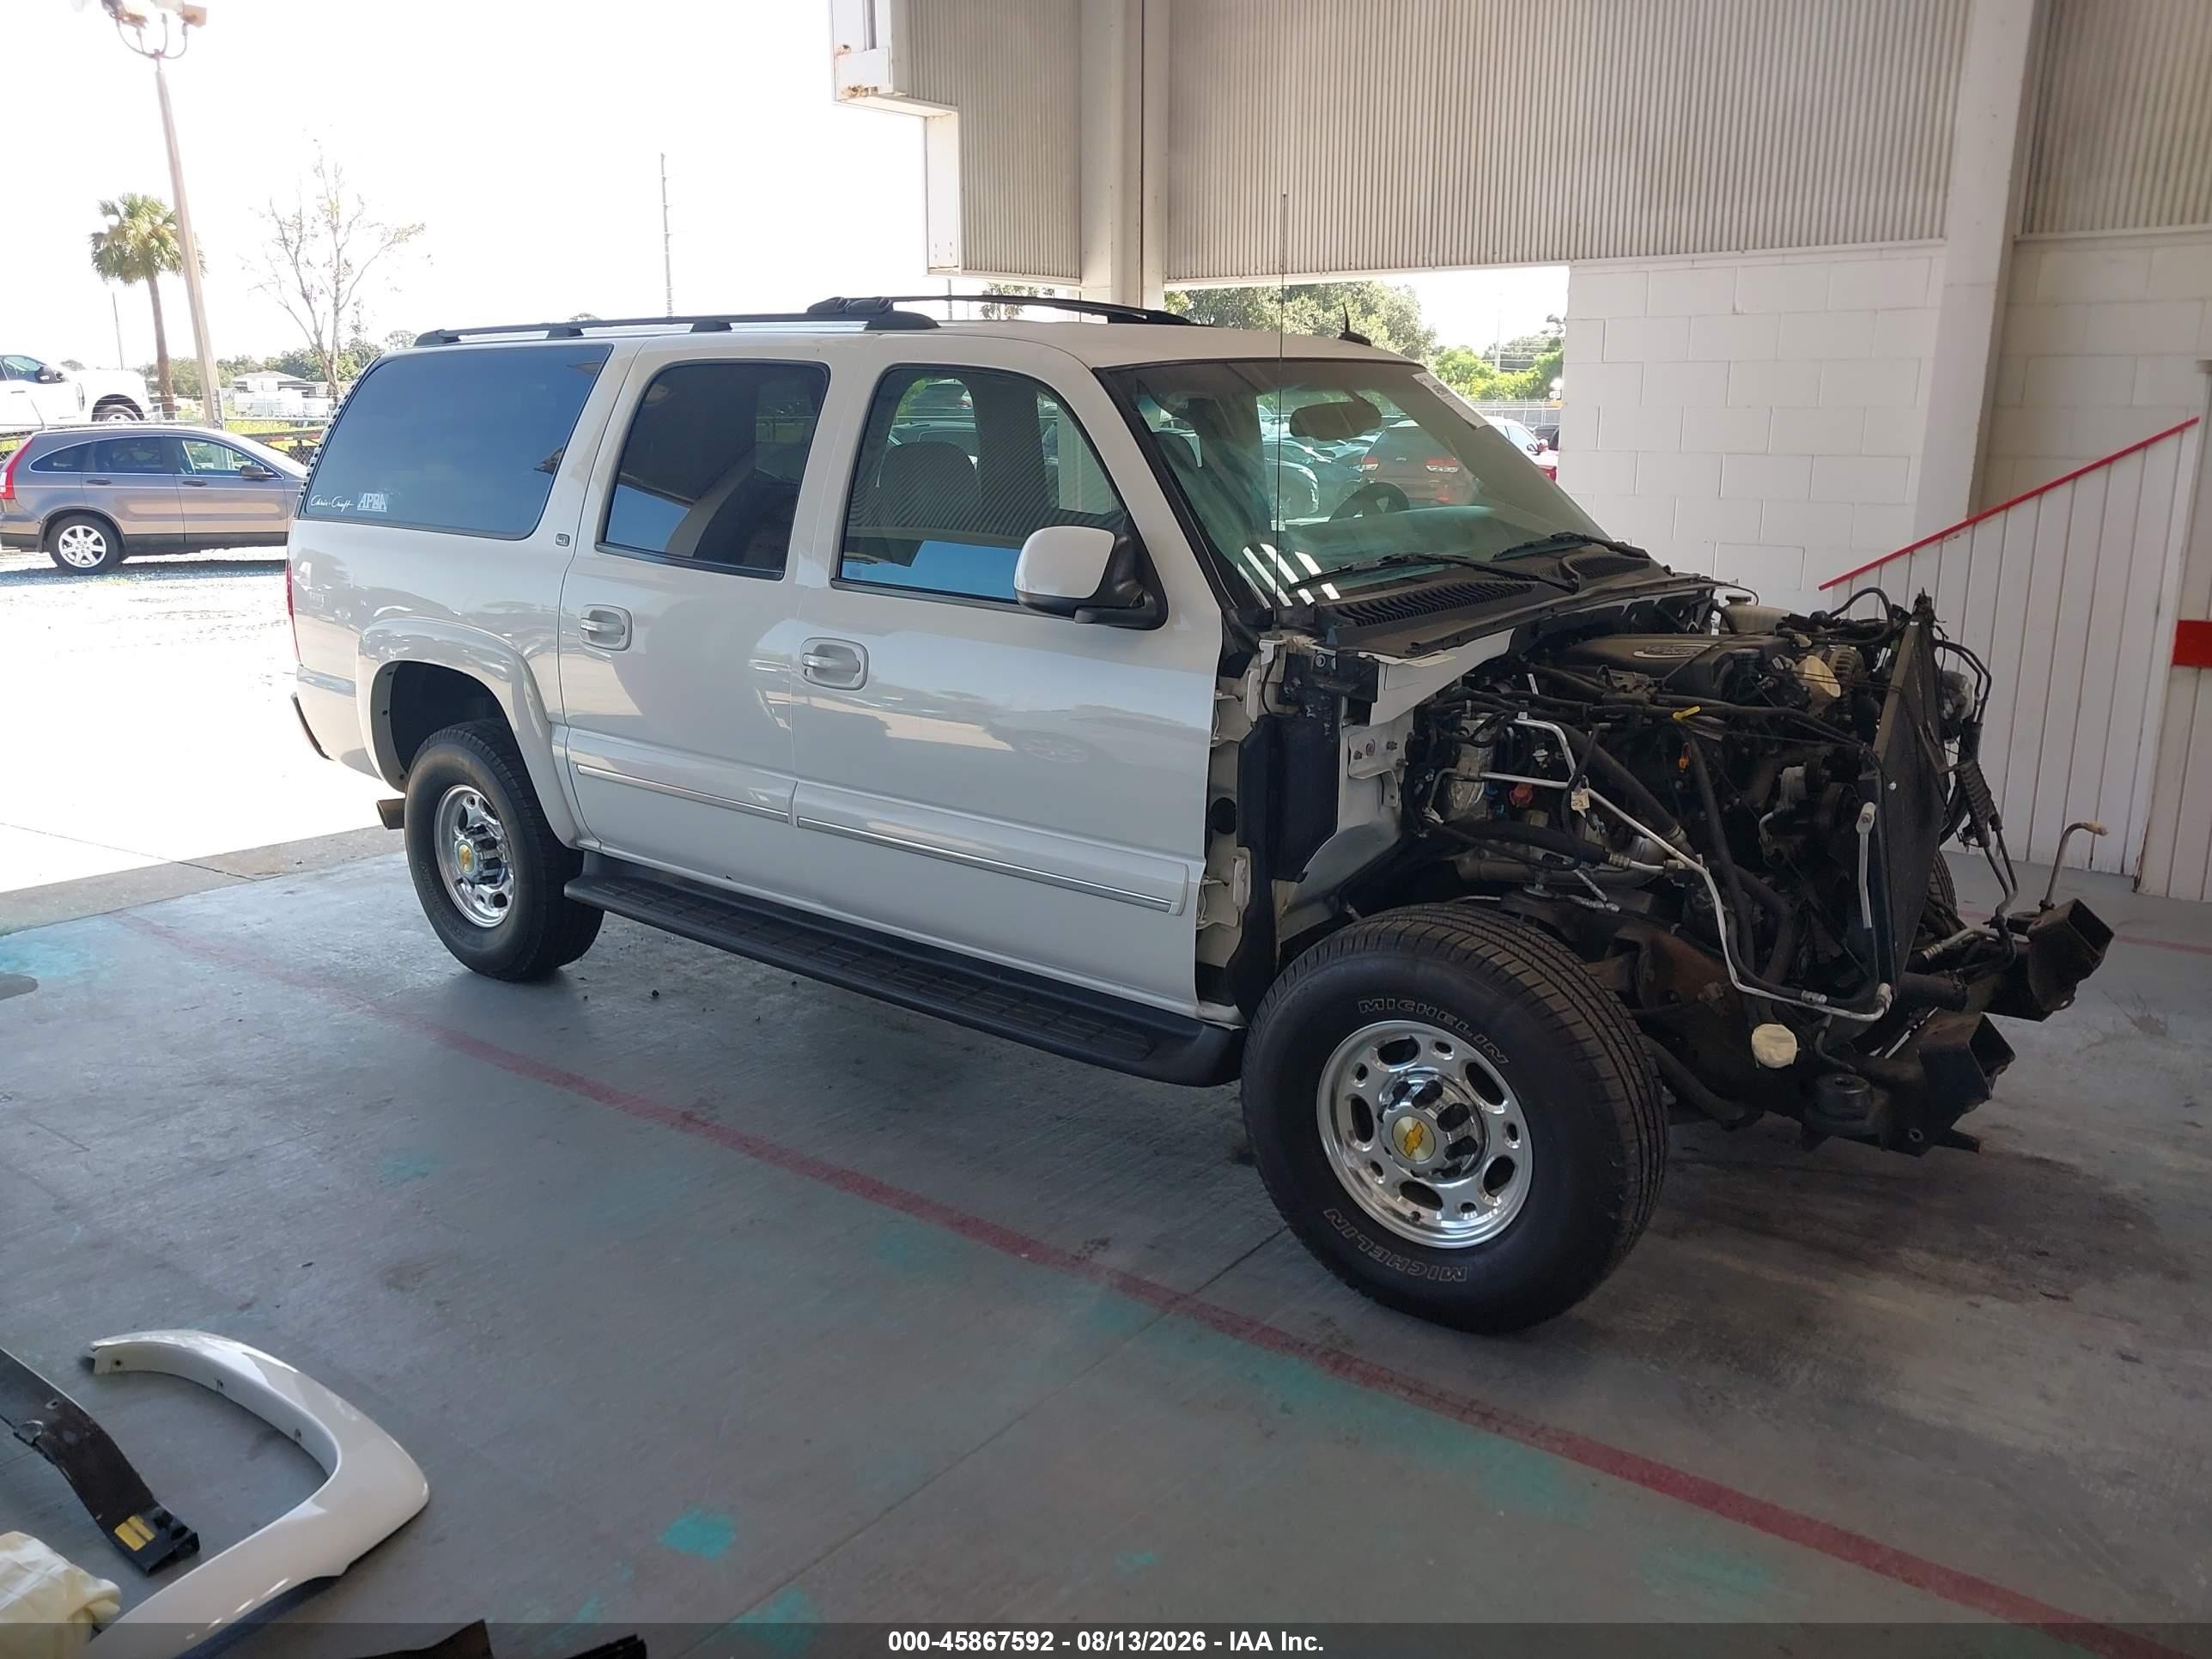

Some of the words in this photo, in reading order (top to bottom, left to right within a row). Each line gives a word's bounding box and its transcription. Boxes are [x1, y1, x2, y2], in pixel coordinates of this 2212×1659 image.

[356, 492, 387, 513] APBA
[1357, 997, 1510, 1066] MICHELIN
[1322, 1207, 1468, 1283] MICHELIN
